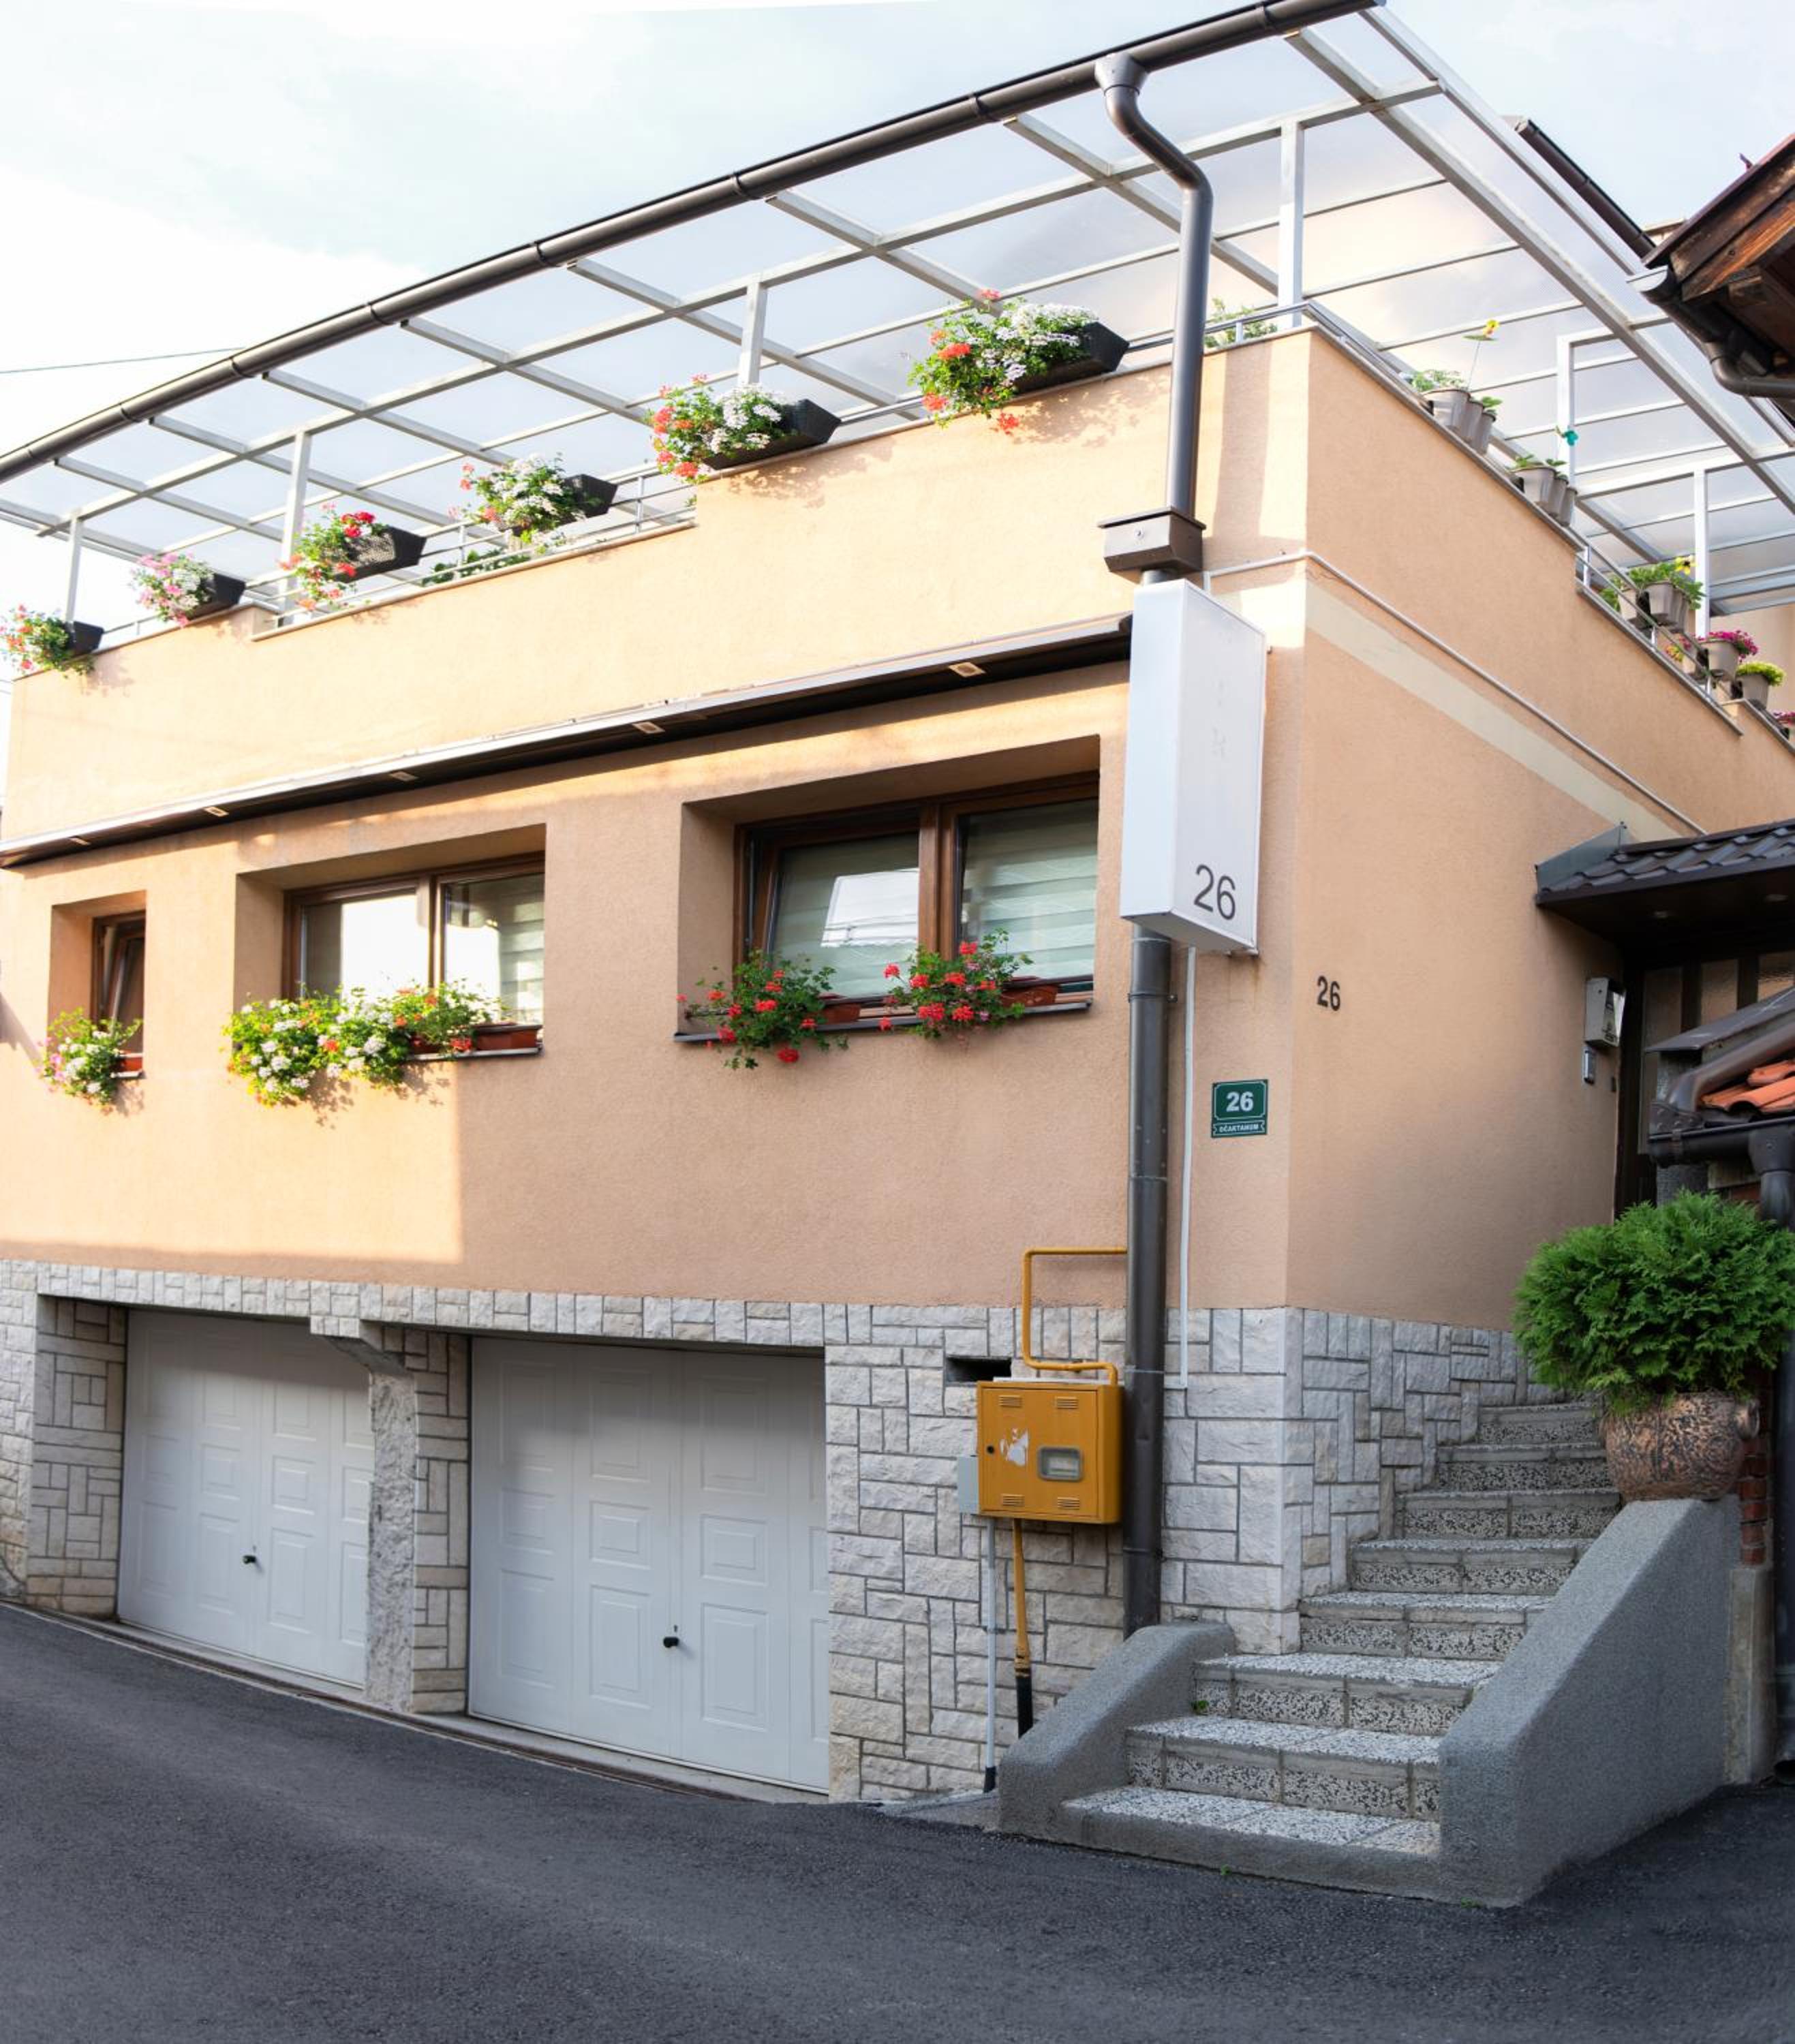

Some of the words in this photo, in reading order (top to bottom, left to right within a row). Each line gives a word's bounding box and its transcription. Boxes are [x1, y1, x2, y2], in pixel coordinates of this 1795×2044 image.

[1194, 864, 1235, 920] 26
[1317, 975, 1340, 1011] 26
[1226, 1091, 1253, 1112] 26
